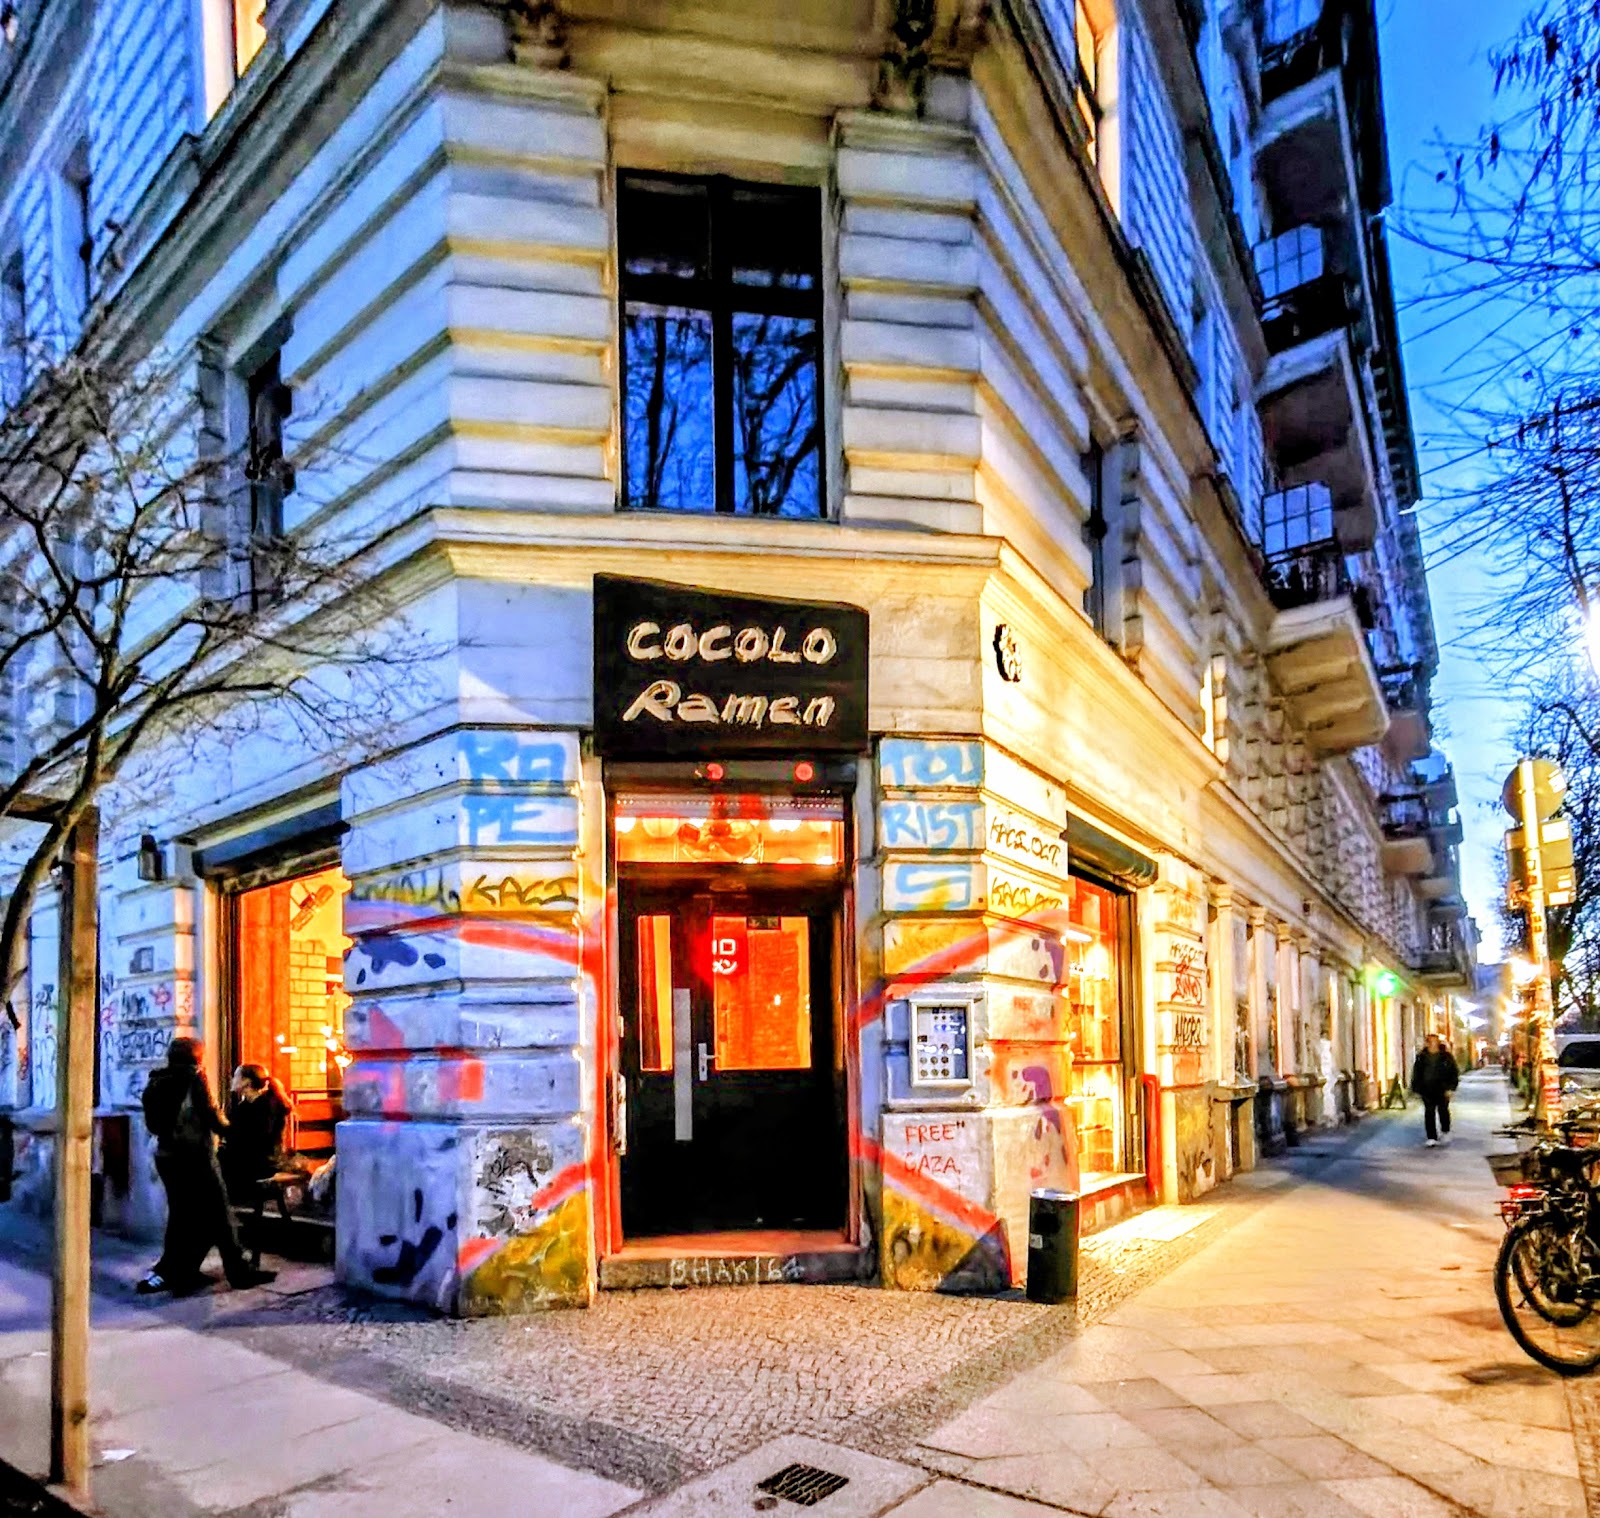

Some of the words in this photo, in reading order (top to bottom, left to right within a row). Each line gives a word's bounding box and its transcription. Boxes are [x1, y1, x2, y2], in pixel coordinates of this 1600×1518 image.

[627, 621, 837, 664] COCOLO
[622, 680, 836, 729] Ramen
[881, 801, 984, 851] RIST
